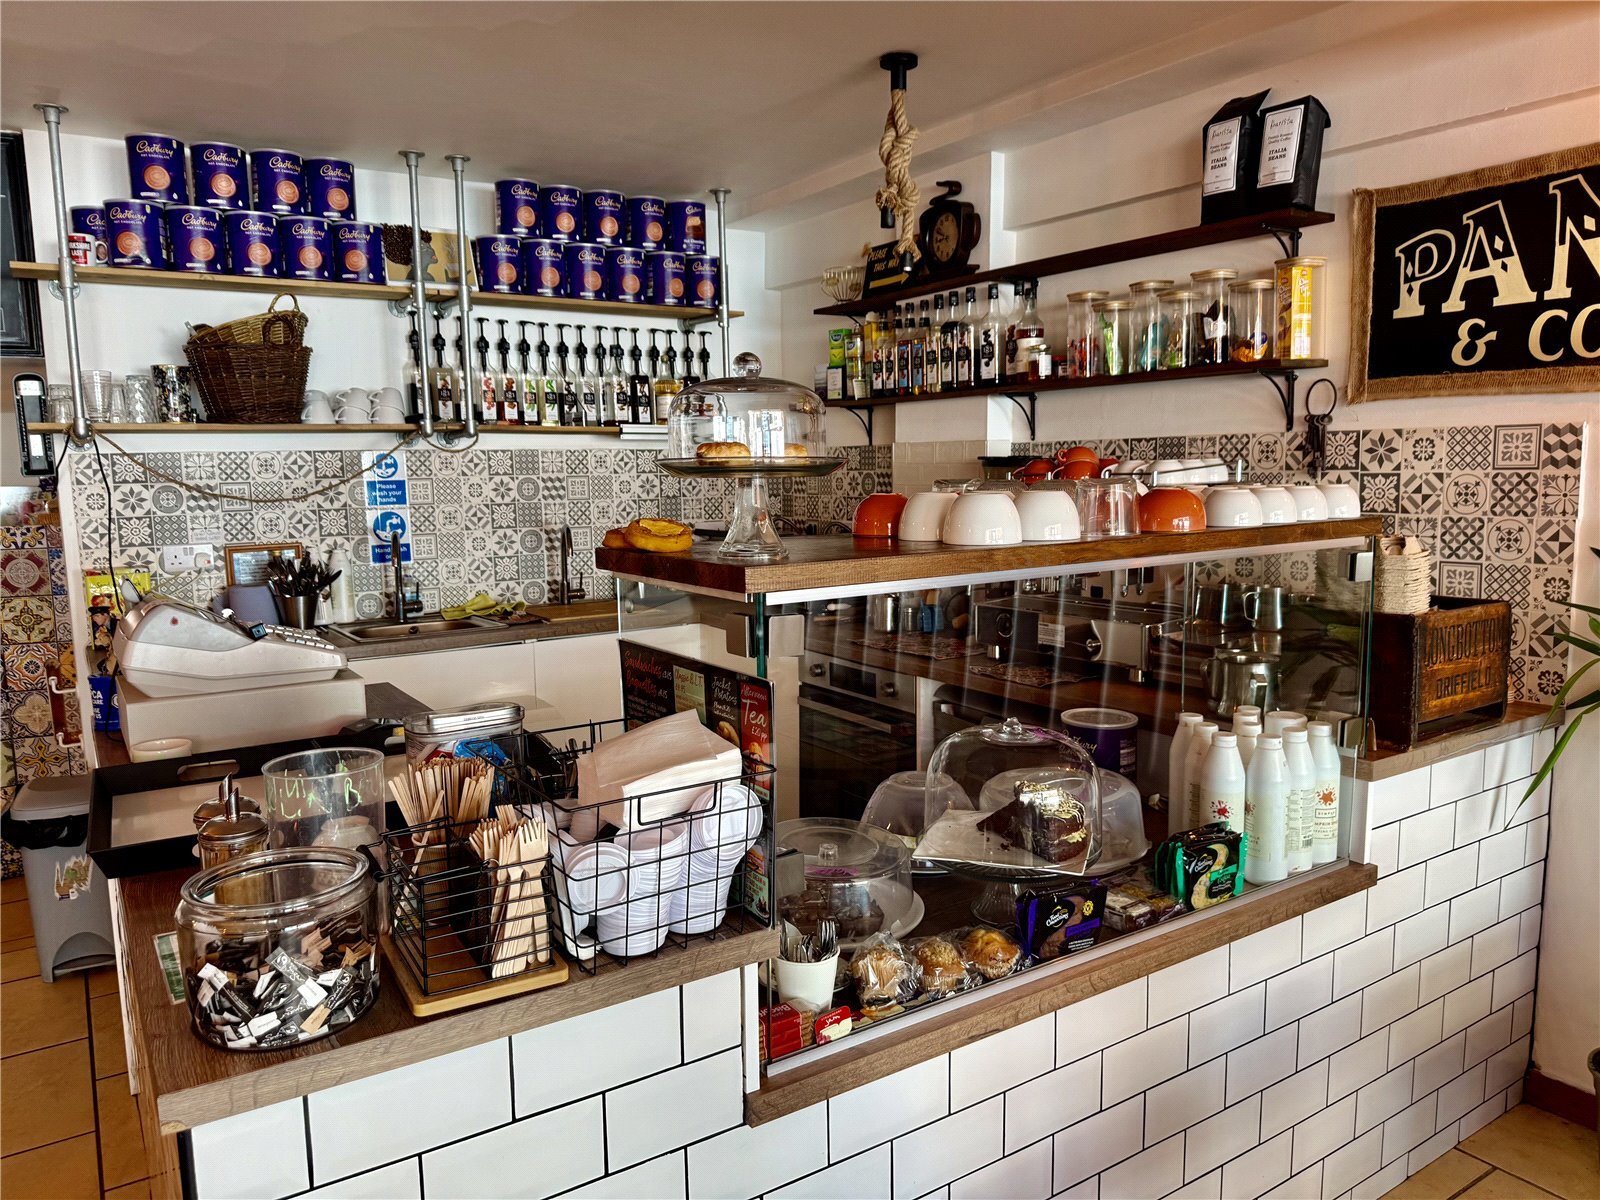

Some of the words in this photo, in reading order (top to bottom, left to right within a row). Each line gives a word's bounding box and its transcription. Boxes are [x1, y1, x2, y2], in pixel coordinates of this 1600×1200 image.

[136, 140, 174, 158] Cadbury
[203, 148, 239, 165] Cadbury
[1268, 147, 1287, 155] ITALIA
[269, 156, 301, 172] Cadbury
[1211, 156, 1227, 164] ITALIA
[1268, 153, 1287, 162] BEANS
[320, 164, 351, 180] Cadbury
[1210, 162, 1227, 170] BEANS
[110, 207, 147, 222] Cadbury
[182, 213, 217, 229] Cadbury
[240, 218, 274, 234] Cadbury
[292, 223, 325, 238] Cadbury
[339, 227, 370, 242] Cadbury
[1451, 318, 1498, 366] &
[741, 698, 767, 728] Tea
